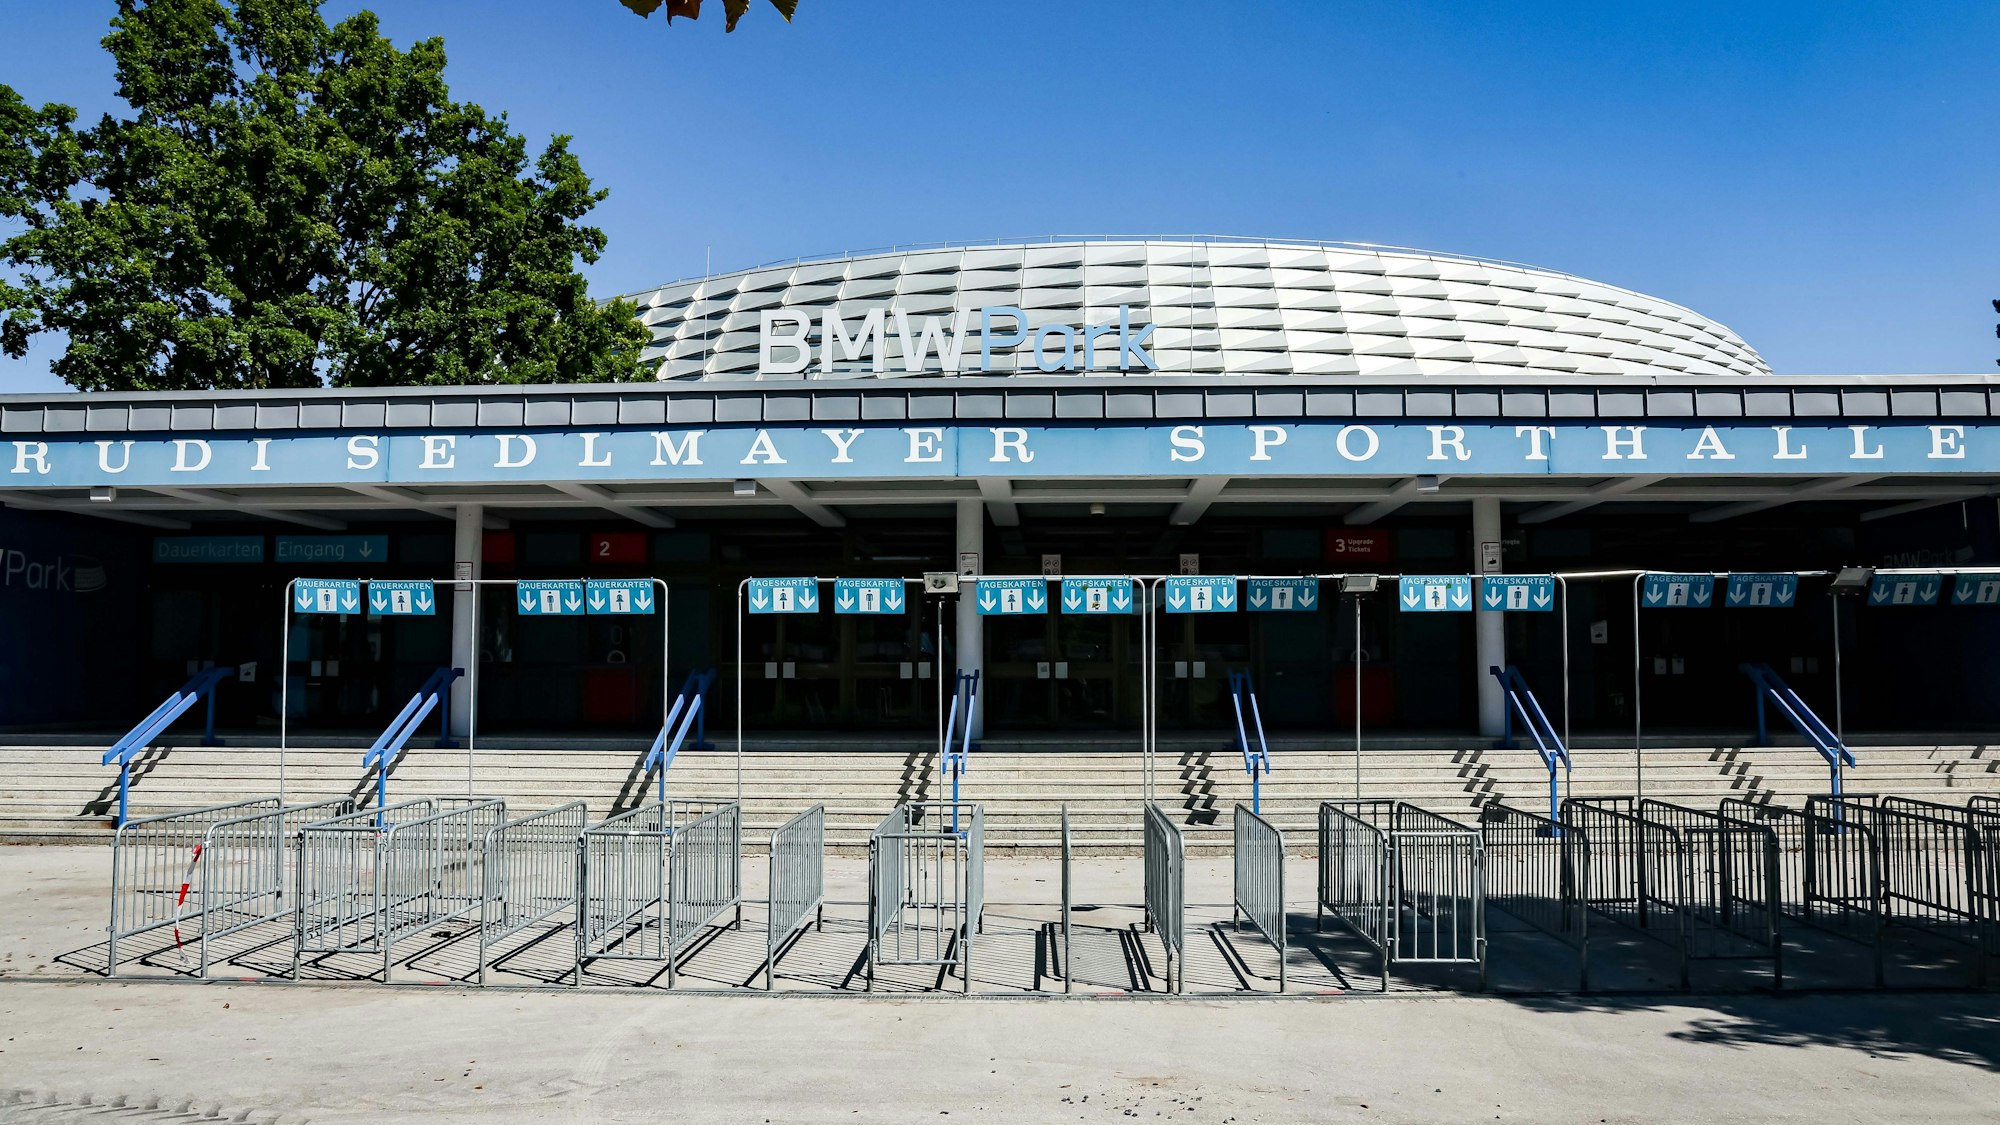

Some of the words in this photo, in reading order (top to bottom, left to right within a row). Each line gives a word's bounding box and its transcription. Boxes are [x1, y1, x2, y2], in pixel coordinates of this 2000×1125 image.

[758, 304, 1160, 374] BMWPark
[11, 438, 272, 475] RUDI
[346, 426, 1036, 470] SEDLMAYER
[1169, 424, 1966, 463] SPORTHALLE
[1335, 538, 1346, 553] 3
[1348, 538, 1374, 546] Upgrade
[157, 540, 262, 559] Dauerkarten
[277, 540, 345, 561] Eingang
[599, 540, 611, 557] 2
[1348, 545, 1371, 553] Tickets
[0, 549, 71, 592] Park
[751, 579, 814, 587] TAGESKARTEN
[1168, 578, 1234, 586] TAGESKARTEN
[1250, 579, 1315, 587] TAGESKARTEN
[1402, 577, 1468, 585] TAGESKARTEN
[1486, 577, 1551, 586] TAGESKARTEN
[1648, 575, 1712, 583] TAGESKARTEN
[1732, 575, 1795, 583] TAGESKARTEN
[296, 580, 357, 589] DAUERKARTEN
[369, 582, 431, 590] DAUERKARTEN
[518, 582, 581, 590] DAUERKARTEN
[587, 581, 651, 589] DAUERKARTEN
[837, 580, 901, 588] TAGESKARTEN
[979, 580, 1044, 588] TAGESKARTEN
